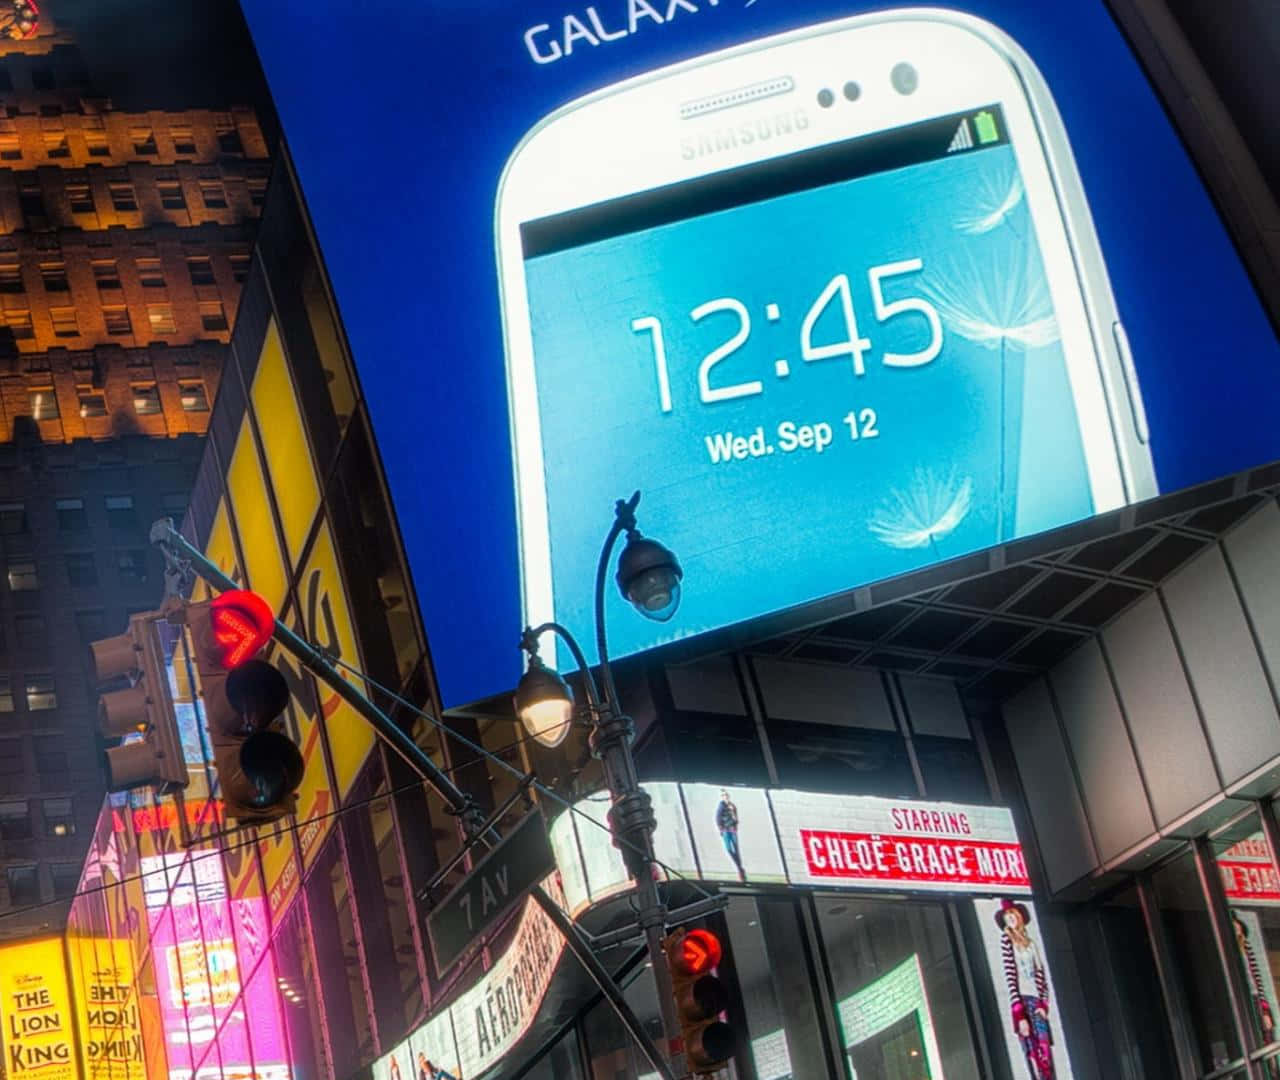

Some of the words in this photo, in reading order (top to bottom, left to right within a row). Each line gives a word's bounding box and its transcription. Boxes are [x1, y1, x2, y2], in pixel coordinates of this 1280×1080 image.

[680, 109, 810, 160] SAMSUNG
[631, 258, 943, 412] 12:45
[705, 426, 773, 464] Wed.
[778, 416, 832, 455] Sep
[844, 407, 879, 441] 12
[892, 808, 971, 836] STARRING
[809, 835, 887, 874] CHLOË
[895, 841, 969, 878] GRACE
[460, 898, 474, 930] 7
[479, 866, 510, 914] AV
[13, 990, 50, 1009] THE
[10, 1013, 60, 1041] LION
[10, 1043, 69, 1073] KING
